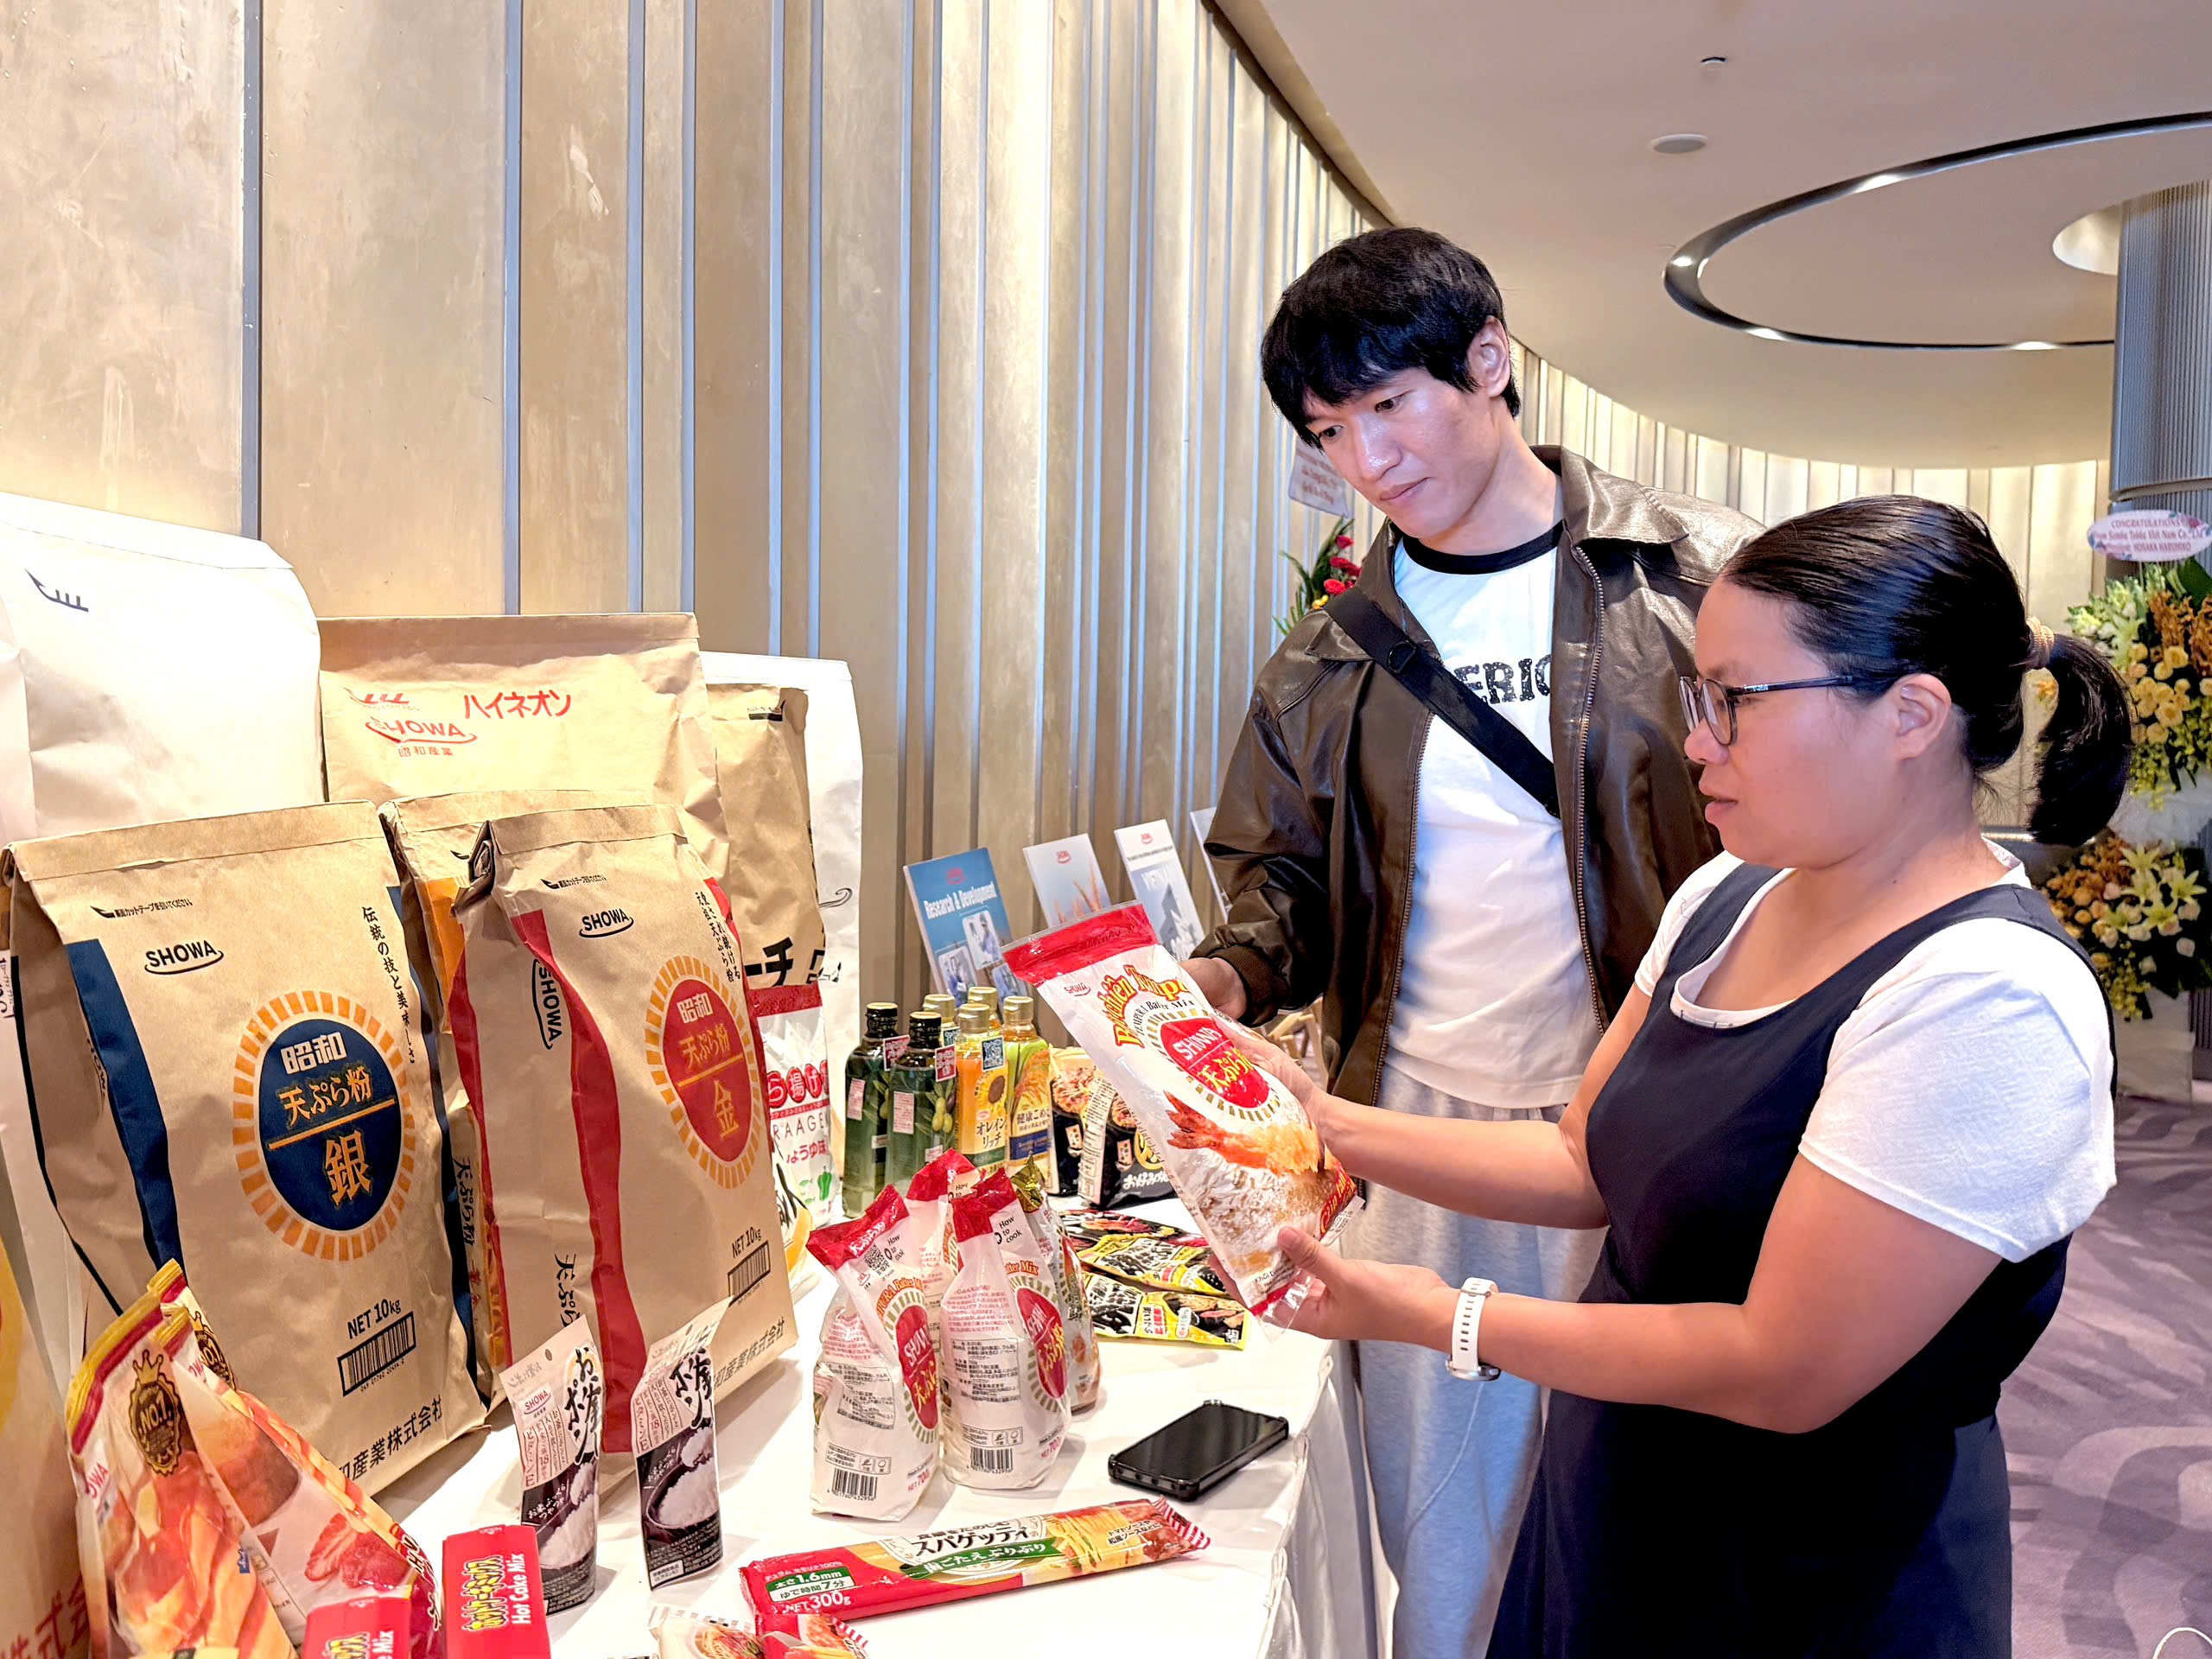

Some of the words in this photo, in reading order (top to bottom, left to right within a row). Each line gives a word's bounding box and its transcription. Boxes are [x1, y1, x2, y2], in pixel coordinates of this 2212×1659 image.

[463, 690, 571, 719] ハイネオン
[370, 716, 467, 737] SHOWA
[582, 908, 630, 931] SHOWA
[146, 940, 218, 967] SHOWA
[362, 906, 416, 1064] 伝統の技と美味しさ
[677, 992, 714, 1024] 昭和
[281, 1032, 347, 1074] 昭和
[678, 1022, 730, 1071] 天ぷら粉
[1173, 1027, 1223, 1060] SHOWA
[278, 1065, 372, 1127] 天ぷら粉
[714, 1079, 740, 1141] 金
[976, 1118, 1006, 1135] オレイン
[982, 1133, 1002, 1148] リッチ
[325, 1129, 372, 1206] 銀
[999, 1216, 1014, 1229] How
[732, 1236, 746, 1258] NET
[887, 1234, 900, 1246] How
[1006, 1230, 1022, 1243] cook
[1020, 1260, 1039, 1275] Mix
[347, 1309, 371, 1338] NET
[373, 1299, 401, 1324] 10kg
[905, 1326, 931, 1367] SHOW
[524, 1389, 549, 1411] SHOWA
[1109, 1520, 1150, 1535] トマトソースや
[912, 1526, 1029, 1556] スパゲッティ
[505, 1554, 527, 1573] Mix
[507, 1575, 530, 1601] Cake
[809, 1591, 851, 1610] 300g
[511, 1604, 532, 1624] Hot
[372, 1630, 394, 1654] Mix
